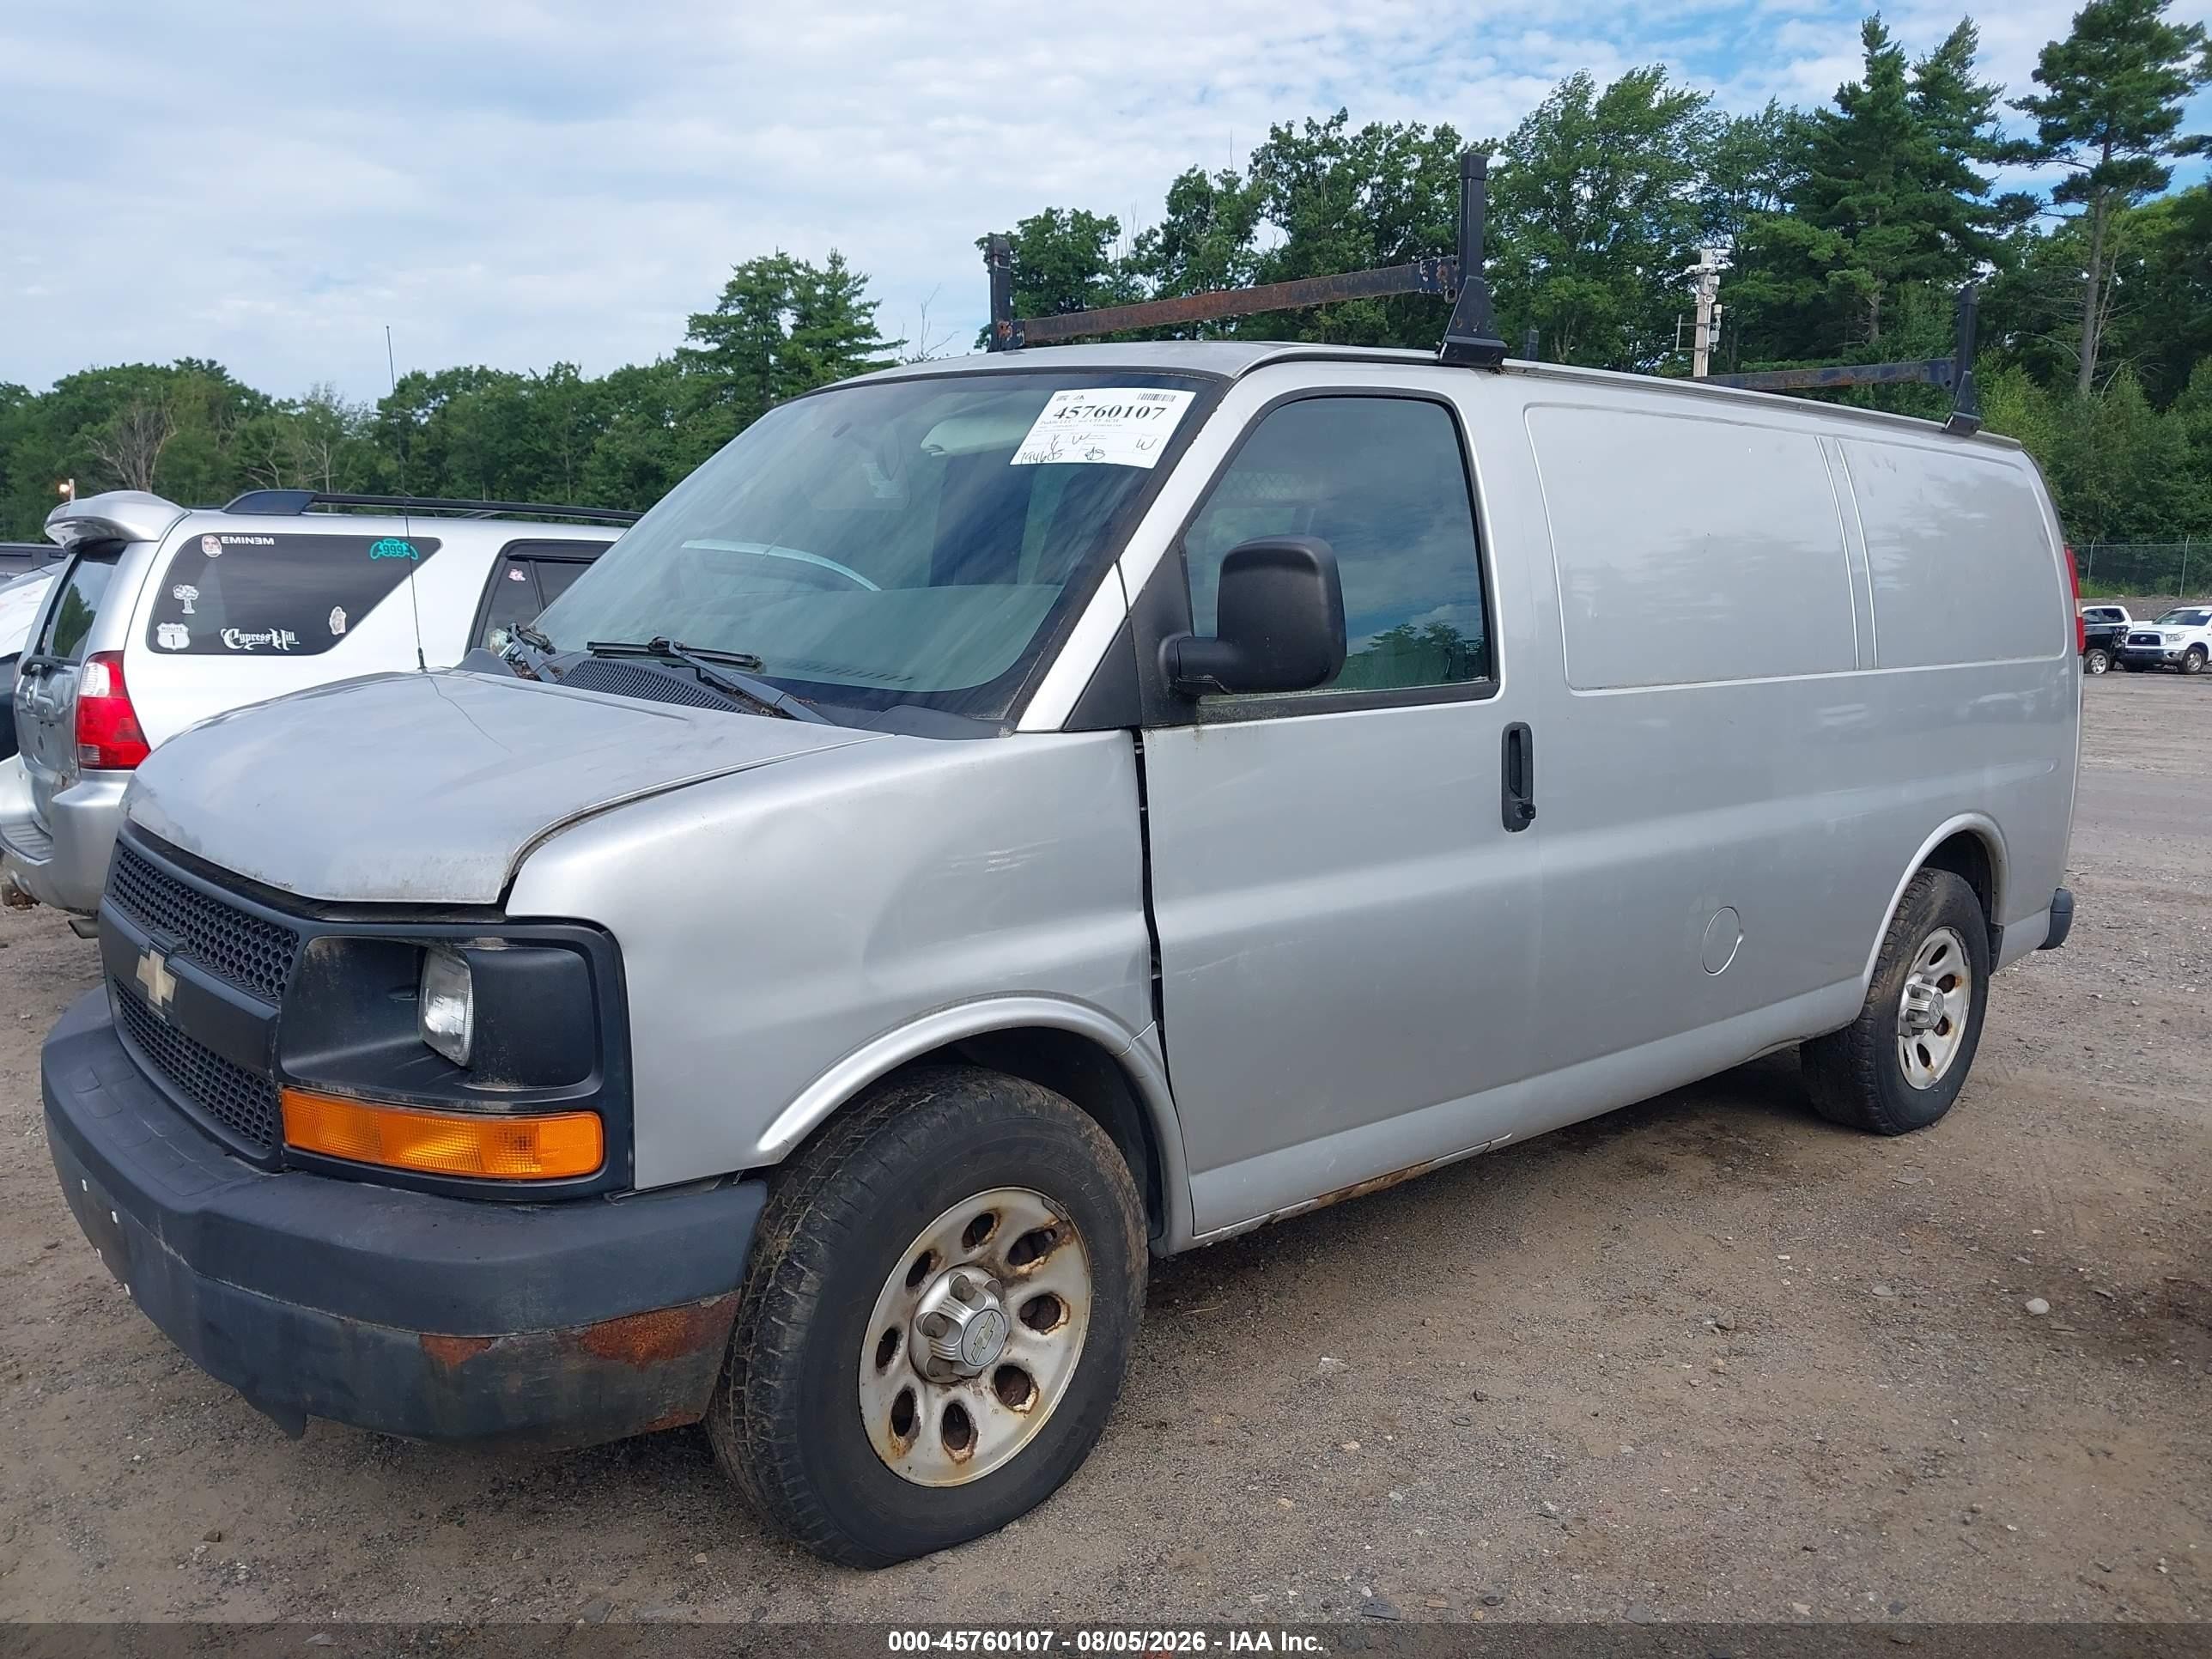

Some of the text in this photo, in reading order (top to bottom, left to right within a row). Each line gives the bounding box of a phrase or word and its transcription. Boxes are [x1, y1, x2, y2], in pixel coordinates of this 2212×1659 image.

[1054, 405, 1167, 421] 45760107
[382, 544, 404, 556] 999
[170, 635, 176, 646] 1
[221, 628, 300, 650] Cypress Hill
